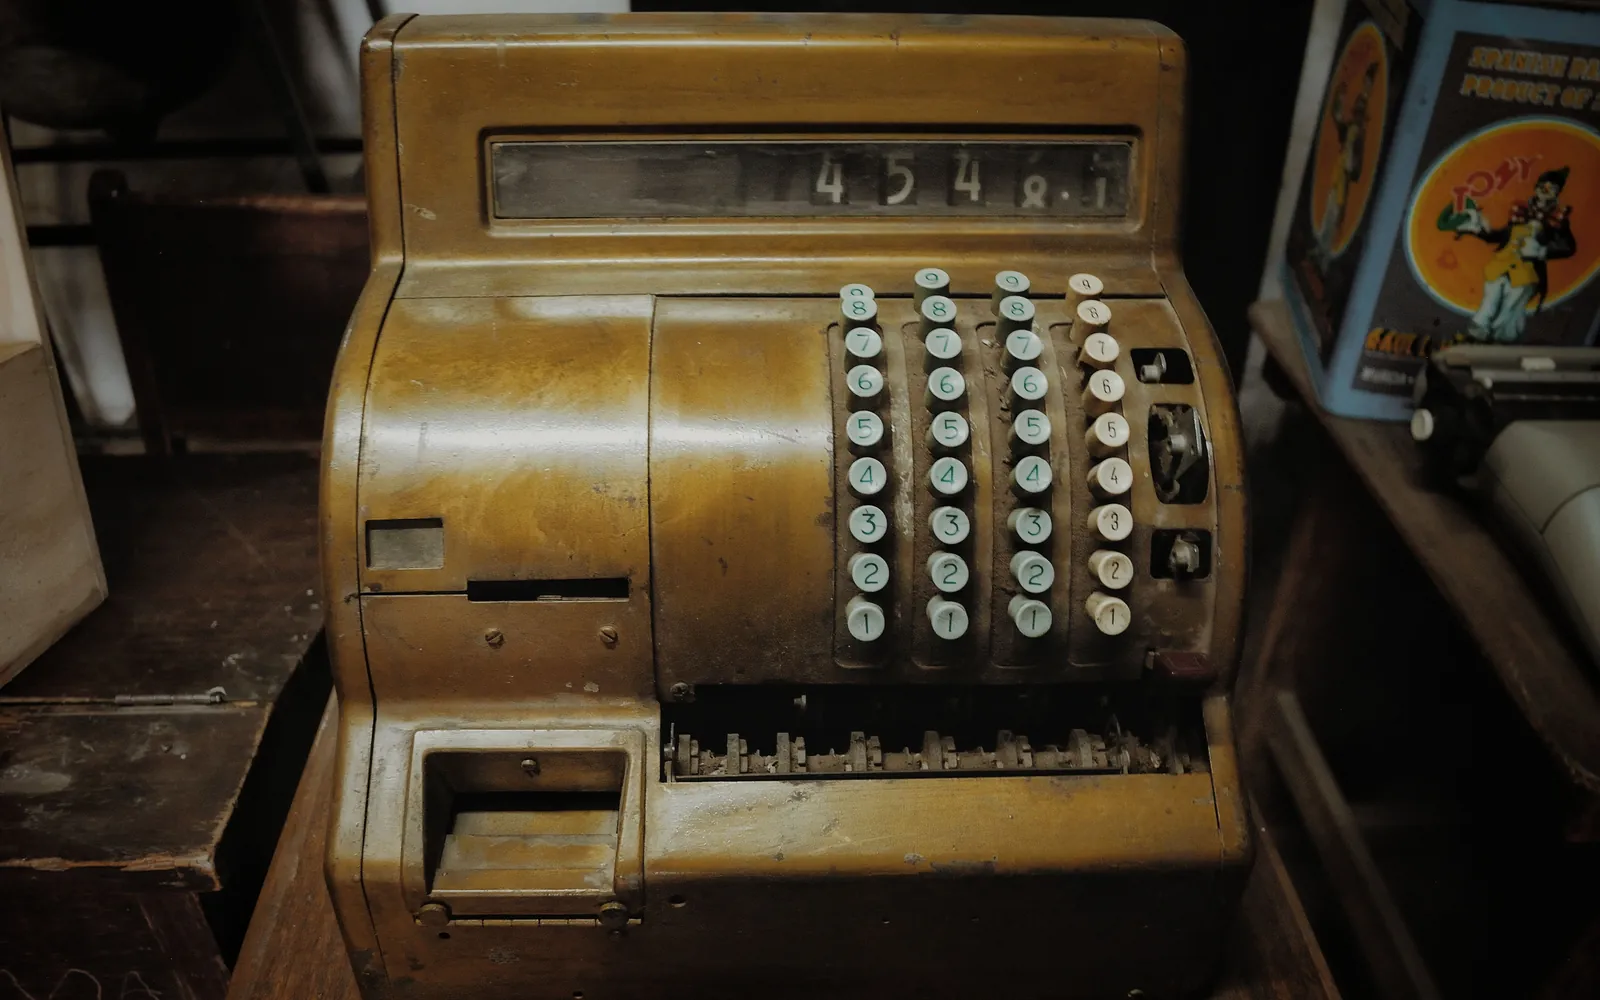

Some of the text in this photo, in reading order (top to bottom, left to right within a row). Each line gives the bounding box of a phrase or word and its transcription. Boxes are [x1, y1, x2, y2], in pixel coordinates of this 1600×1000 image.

[1459, 73, 1561, 107] PRODUCT
[1561, 85, 1593, 110] OF
[816, 154, 844, 203] 4
[886, 153, 914, 205] 5
[954, 153, 981, 201] 4
[852, 300, 867, 315] 8
[932, 302, 946, 317] 8
[1011, 302, 1025, 316] 8
[856, 334, 870, 352] 7
[936, 334, 949, 352] 7
[1016, 336, 1031, 354] 7
[858, 372, 872, 390] 6
[940, 374, 954, 394] 6
[1023, 375, 1038, 394] 6
[857, 418, 872, 439] 5
[944, 419, 959, 440] 5
[1027, 417, 1041, 436] 5
[860, 465, 874, 486] 4
[940, 465, 954, 484] 4
[1026, 464, 1040, 484] 4
[861, 512, 876, 535] 3
[944, 514, 958, 536] 3
[1028, 514, 1042, 536] 3
[863, 562, 879, 584] 2
[942, 563, 957, 585] 2
[1028, 564, 1044, 586] 2
